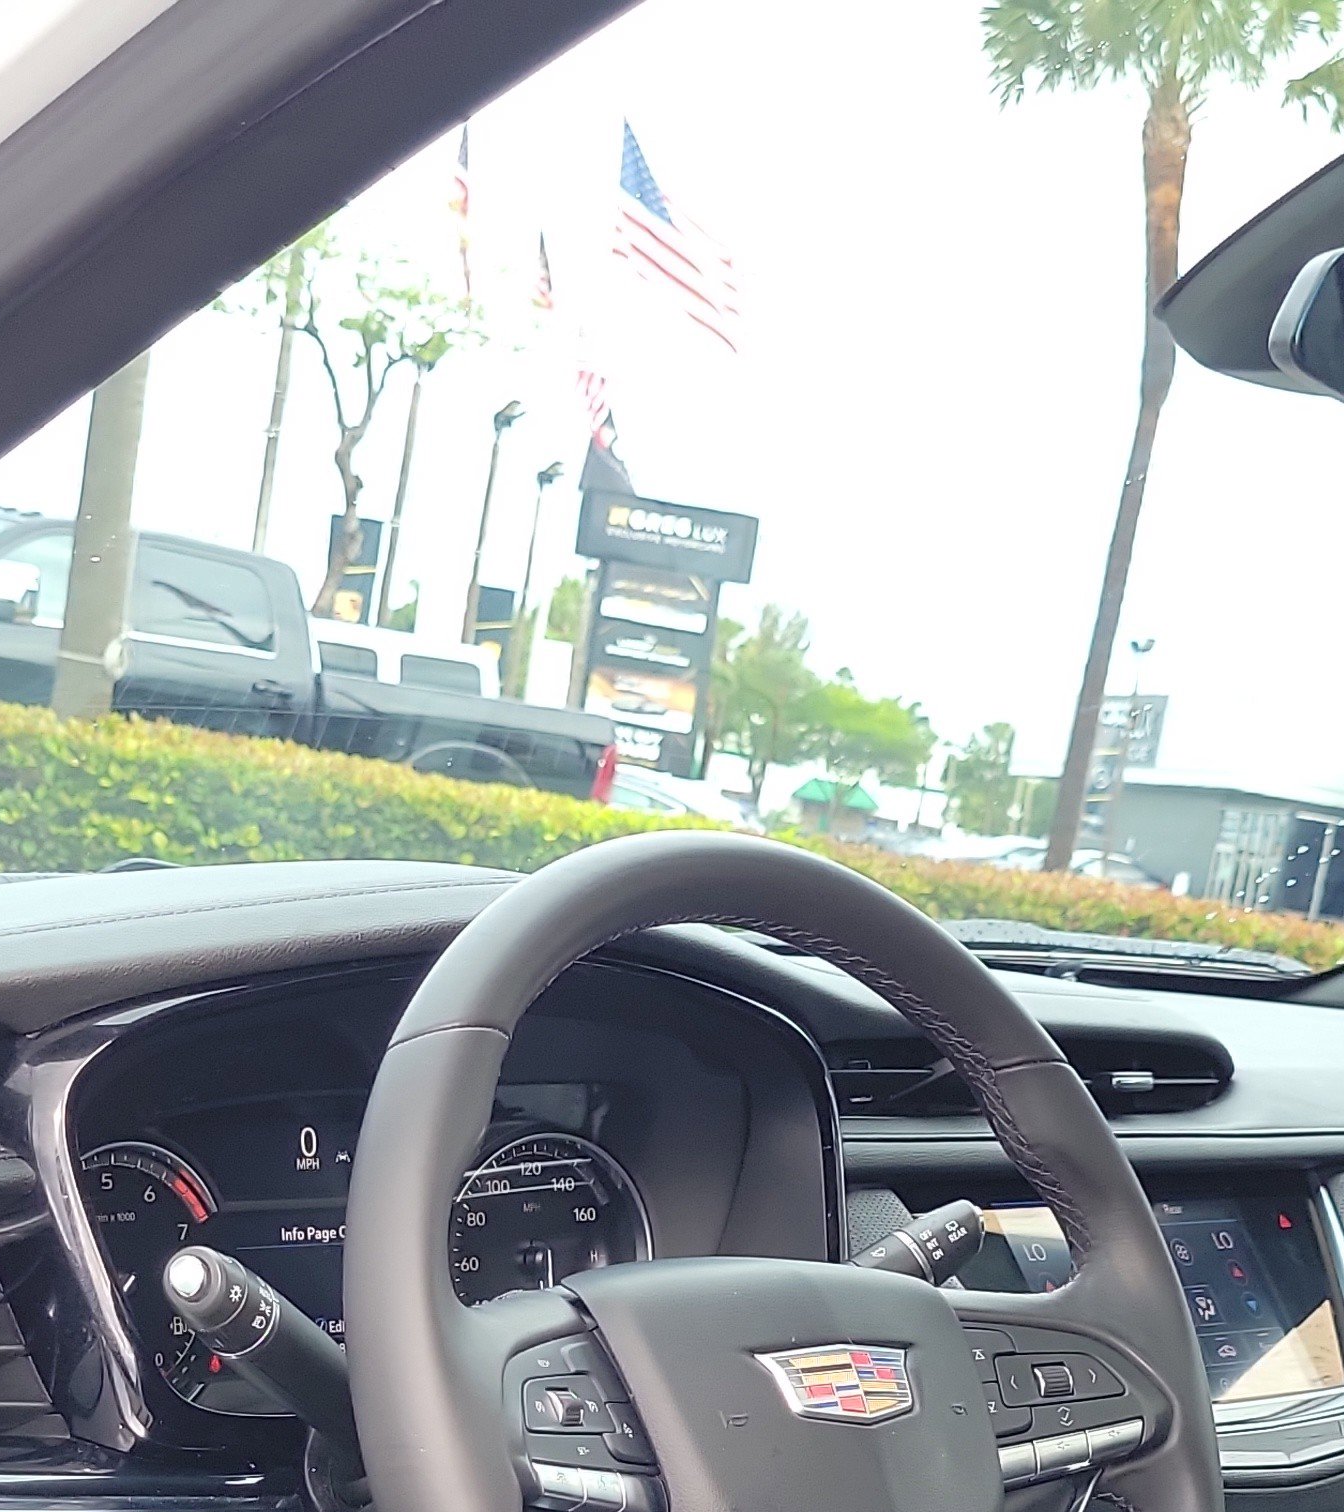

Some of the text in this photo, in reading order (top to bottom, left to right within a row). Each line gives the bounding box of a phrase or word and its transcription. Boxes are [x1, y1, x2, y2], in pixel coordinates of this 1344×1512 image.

[300, 1126, 317, 1158] 0
[296, 1157, 320, 1171] MPH
[519, 1162, 542, 1176] 120
[101, 1173, 113, 1190] 5
[485, 1179, 511, 1193] 100
[550, 1177, 576, 1192] 140
[143, 1185, 156, 1203] 6
[466, 1211, 486, 1227] 80
[573, 1207, 596, 1222] 160
[177, 1223, 189, 1241] 7
[281, 1226, 305, 1241] Info
[307, 1226, 337, 1243] Page
[948, 1227, 968, 1243] REAR
[1211, 1231, 1234, 1250] LO
[1022, 1243, 1047, 1262] LO
[460, 1257, 479, 1271] 60
